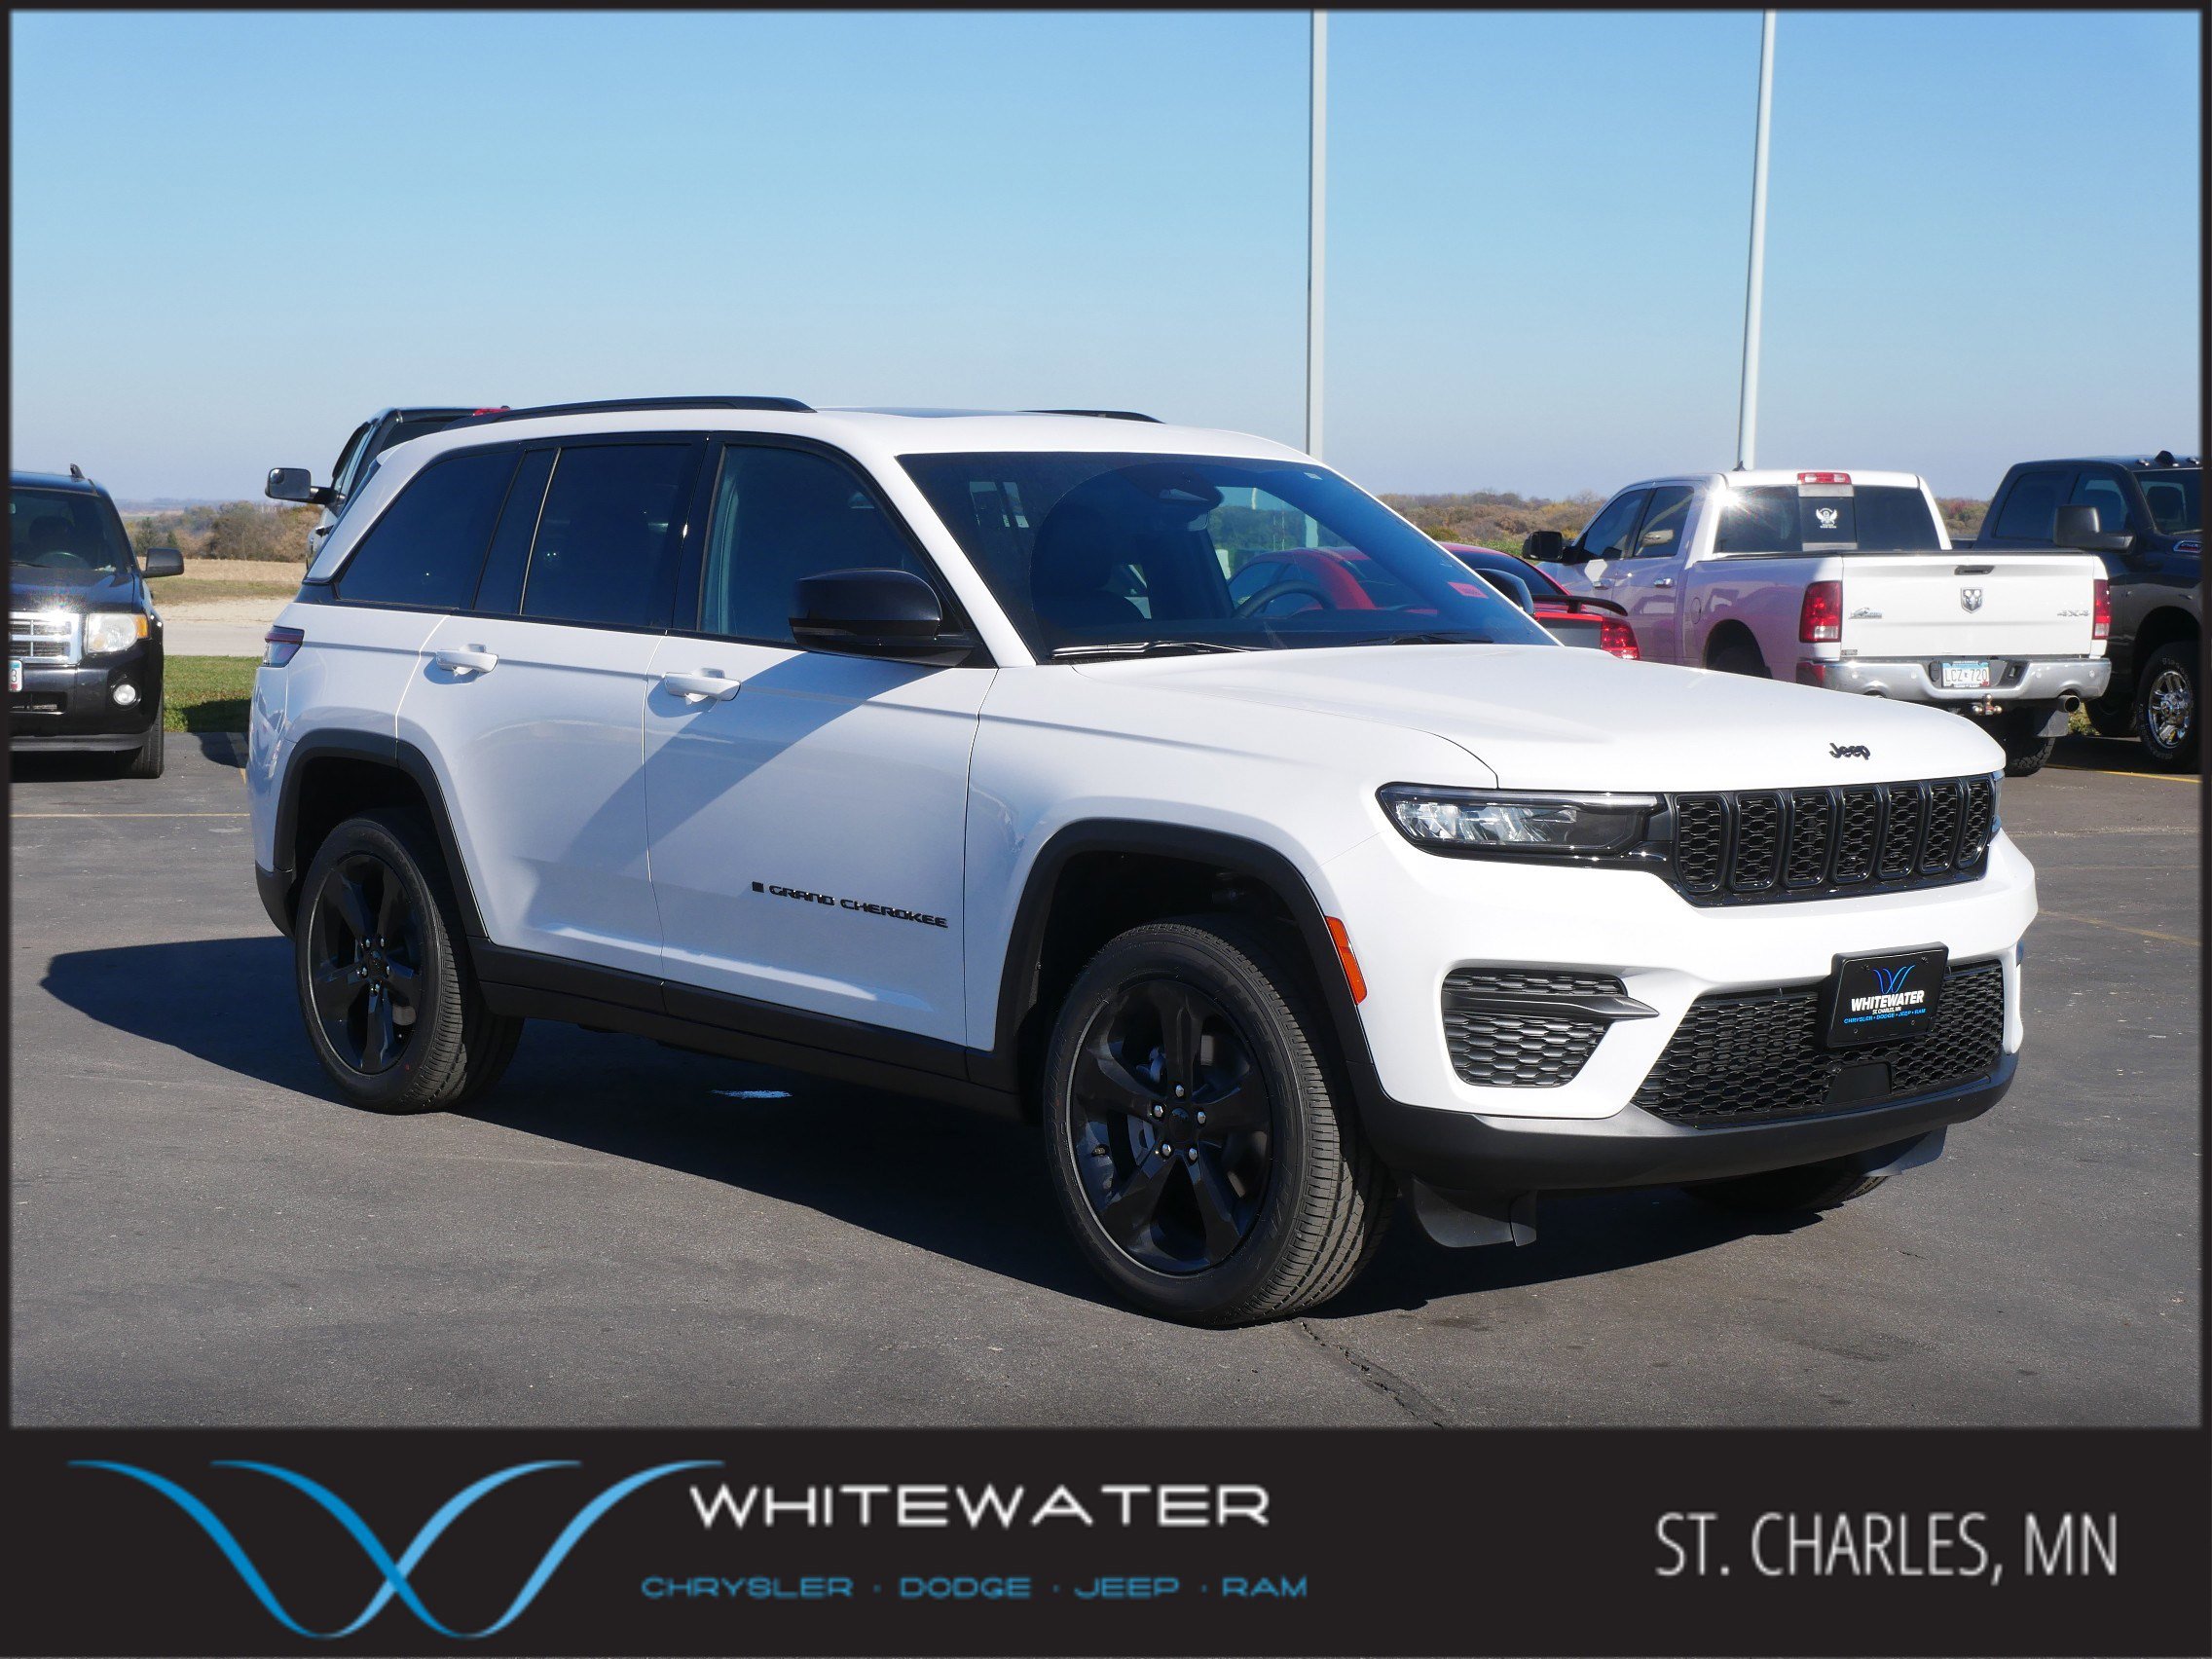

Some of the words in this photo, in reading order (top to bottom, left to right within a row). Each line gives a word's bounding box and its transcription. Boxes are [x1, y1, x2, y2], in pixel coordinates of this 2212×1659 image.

[1828, 742, 1871, 760] Jeep
[768, 884, 835, 906] GRAND
[839, 899, 948, 929] CHEROKEE
[1851, 989, 1925, 1013] WHITEWATER
[1843, 1015, 1873, 1024] CHRYSLER
